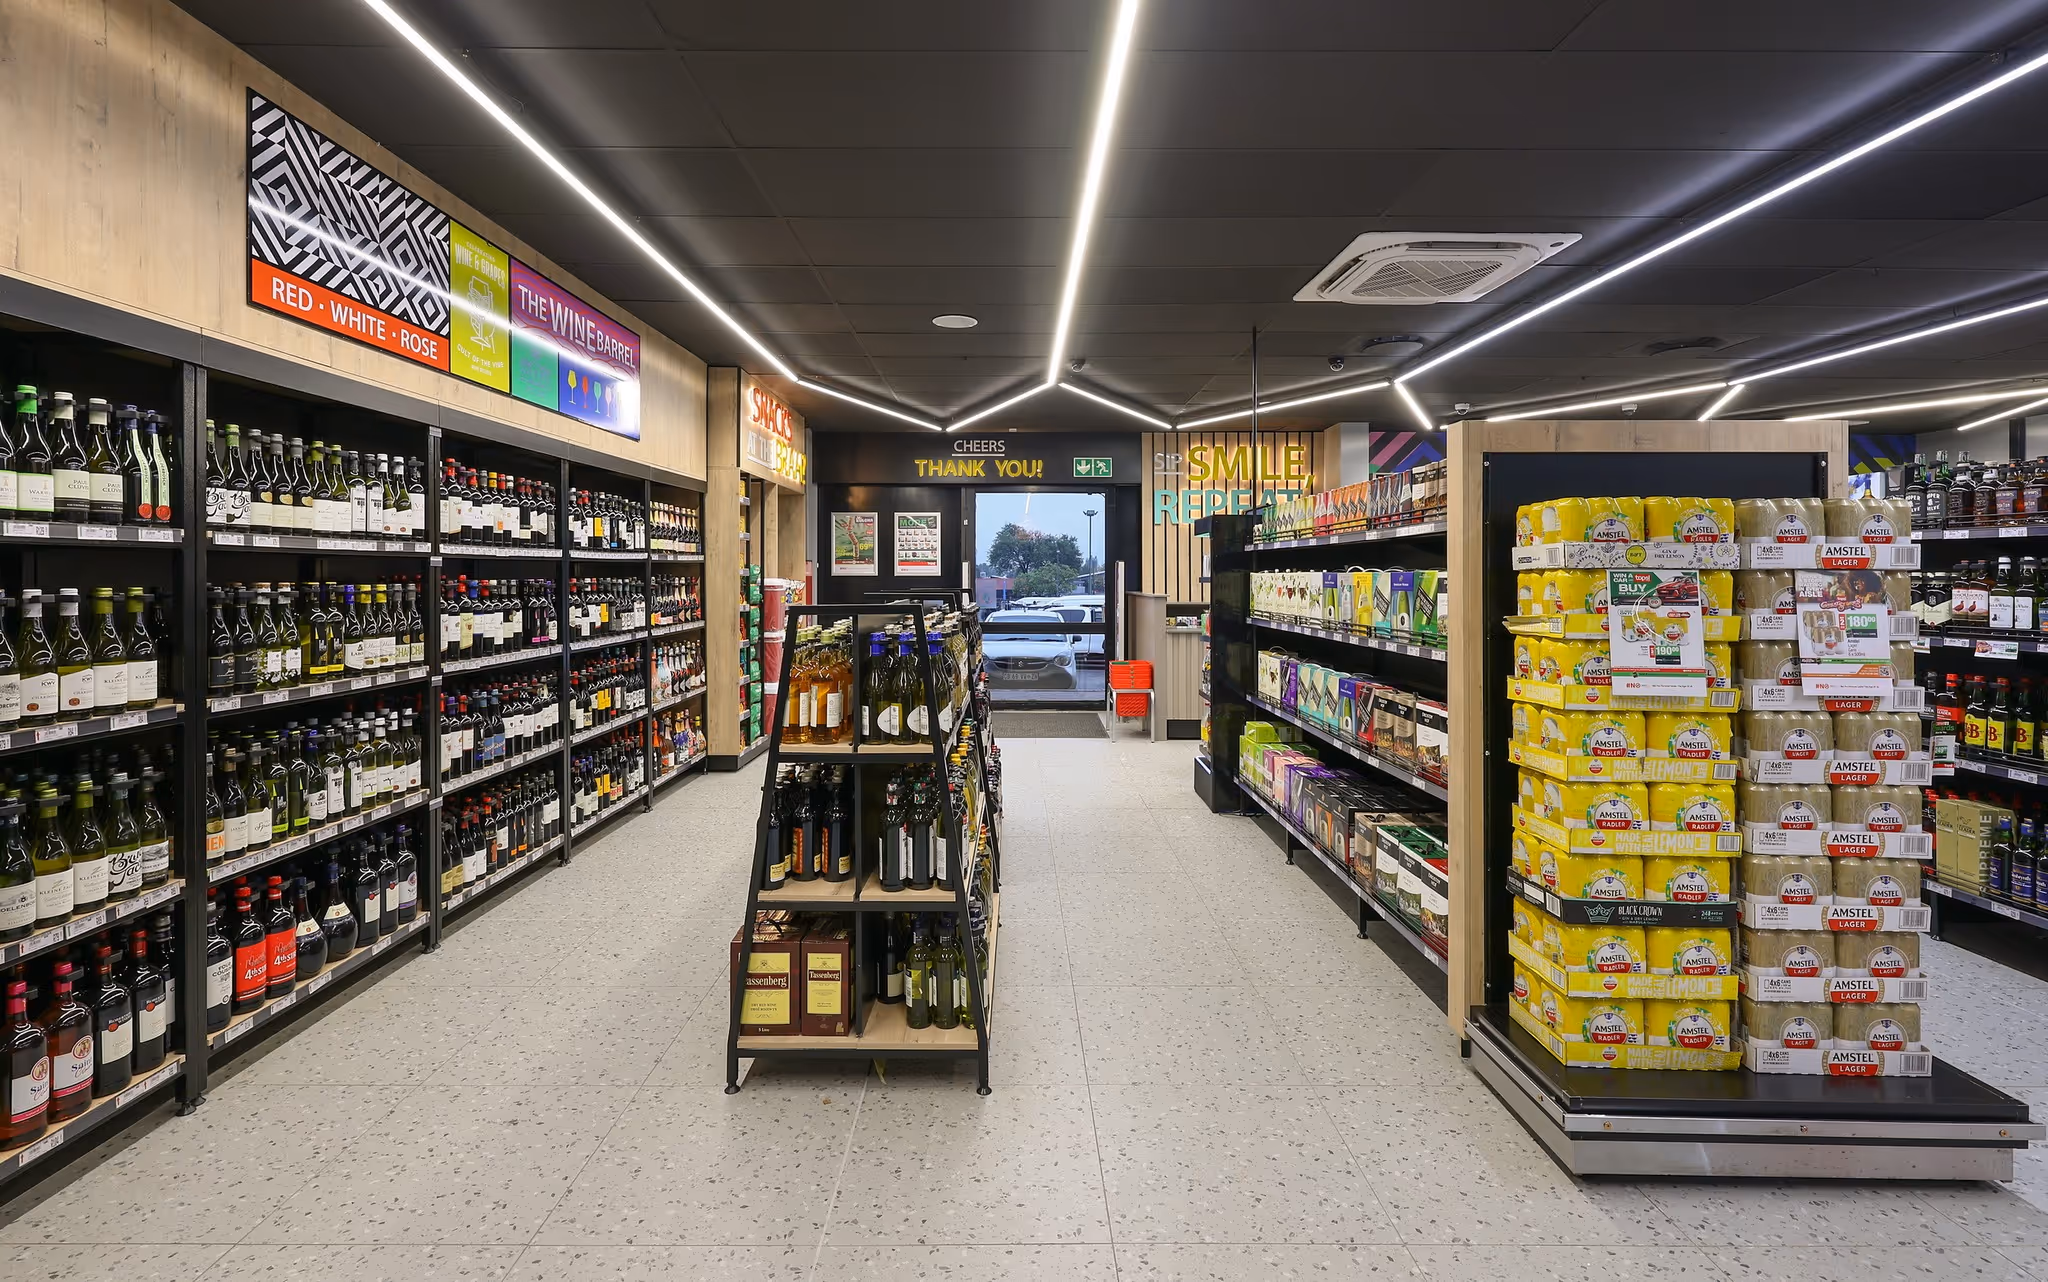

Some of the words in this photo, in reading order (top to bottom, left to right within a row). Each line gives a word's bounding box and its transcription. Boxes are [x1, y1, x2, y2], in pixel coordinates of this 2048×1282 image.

[454, 243, 473, 267] WINE
[475, 255, 480, 270] &
[481, 257, 506, 288] GRAPES
[272, 277, 313, 311] RED
[330, 300, 386, 340] WHITE
[400, 329, 438, 360] ROSE
[518, 284, 548, 322] THE
[549, 296, 596, 352] WINE
[596, 328, 636, 369] BARREL
[953, 440, 1006, 452] CHEERS
[1154, 452, 1183, 471] SIP
[914, 459, 986, 478] THANK
[995, 459, 1043, 478] YOU!
[1596, 530, 1625, 539] AMSTEL
[1687, 526, 1715, 534] AMSTEL
[1762, 546, 1773, 554] 4x6
[1825, 546, 1866, 556] AMSTEL
[1619, 584, 1646, 592] BUY
[1761, 616, 1773, 624] 4x6
[1586, 668, 1611, 676] AMSTE
[1763, 688, 1775, 696] 4x6
[1595, 740, 1623, 748] AMSTEL
[1680, 741, 1708, 749] AMSTEL
[1597, 749, 1622, 757] RADLER
[1614, 760, 1637, 770] MADE
[1770, 761, 1782, 769] 4x6
[1834, 762, 1876, 771] AMSTEL
[1652, 760, 1691, 780] LEMON
[1689, 813, 1718, 821] AMSTEL
[1616, 832, 1641, 843] MADE
[1832, 834, 1874, 844] AMSTEL
[1654, 833, 1694, 853] LEMON
[1676, 884, 1704, 892] AMSTEL
[1594, 889, 1622, 897] AMSTEL
[1618, 906, 1638, 915] BLACK
[1639, 906, 1662, 917] CROWN
[1766, 906, 1778, 914] 4x6
[1831, 908, 1873, 917] AMSTEL
[809, 971, 840, 980] Tassenberg
[1689, 967, 1710, 975] RADLER
[746, 976, 787, 988] assenberg
[1769, 979, 1781, 987] 4x6
[1834, 980, 1874, 990] AMSTEL
[1595, 1025, 1623, 1033] AMSTEL
[1768, 1051, 1780, 1059] 4x6
[1832, 1053, 1874, 1062] AMSTEL
